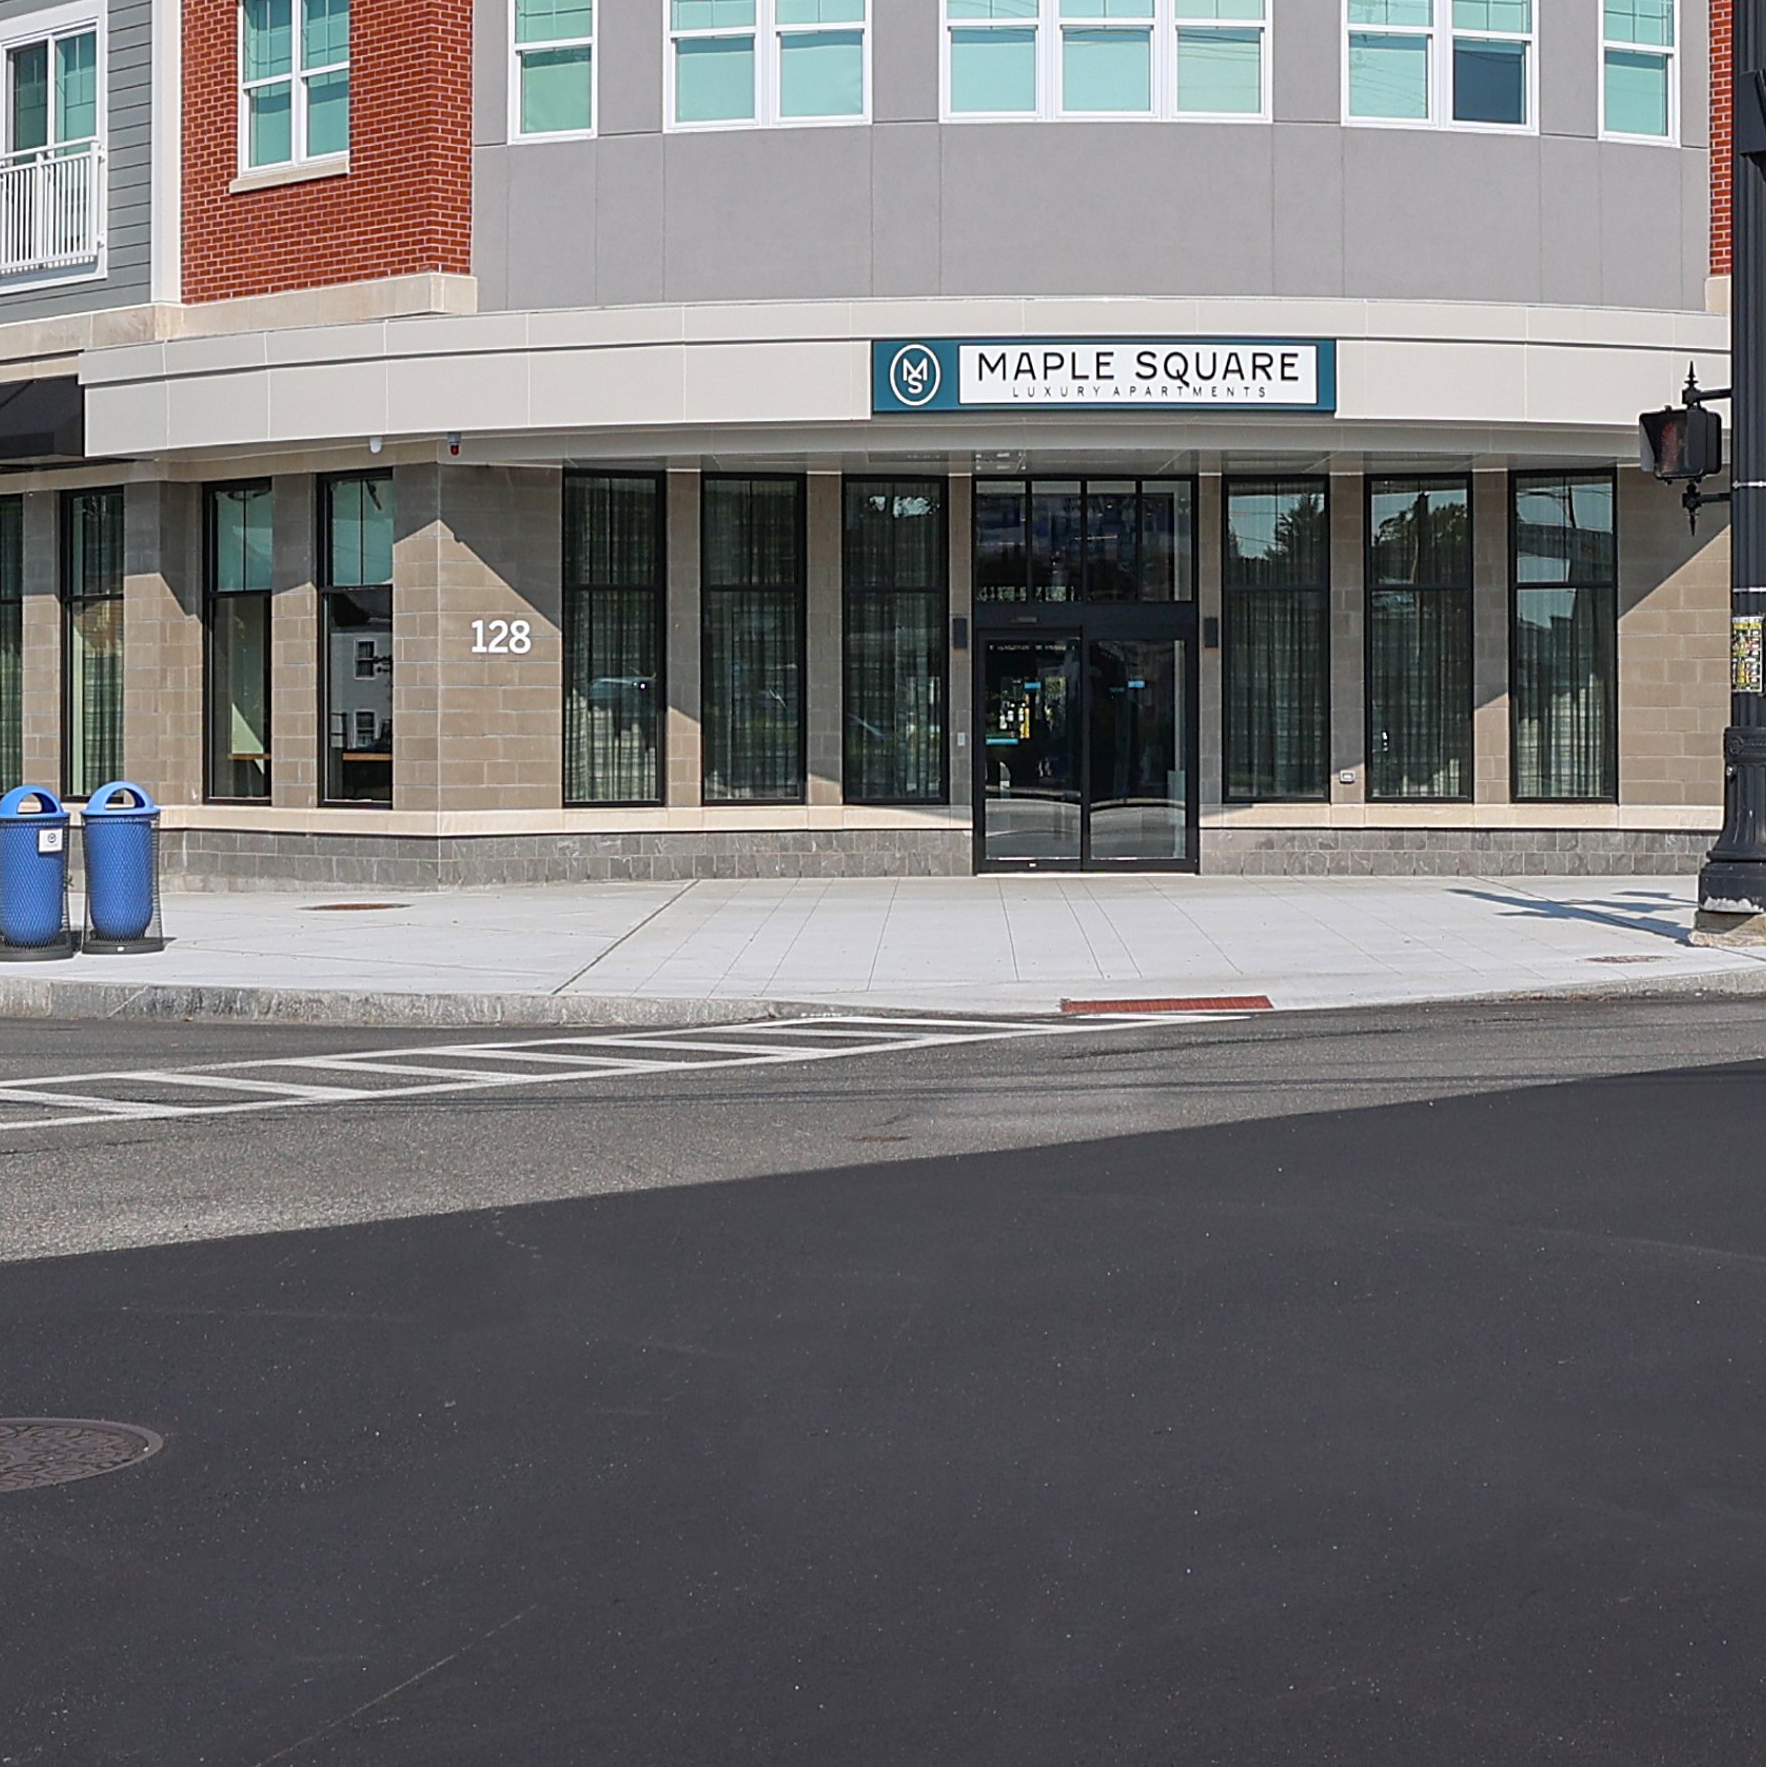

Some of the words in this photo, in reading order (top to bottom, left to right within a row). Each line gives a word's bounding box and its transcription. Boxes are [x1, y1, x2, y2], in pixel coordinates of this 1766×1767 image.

[978, 351, 1114, 382] MAPLE
[1135, 350, 1299, 388] SQUARE
[1012, 386, 1101, 398] LUXURY
[1112, 386, 1266, 398] APARTMENTS
[471, 619, 532, 655] 128
